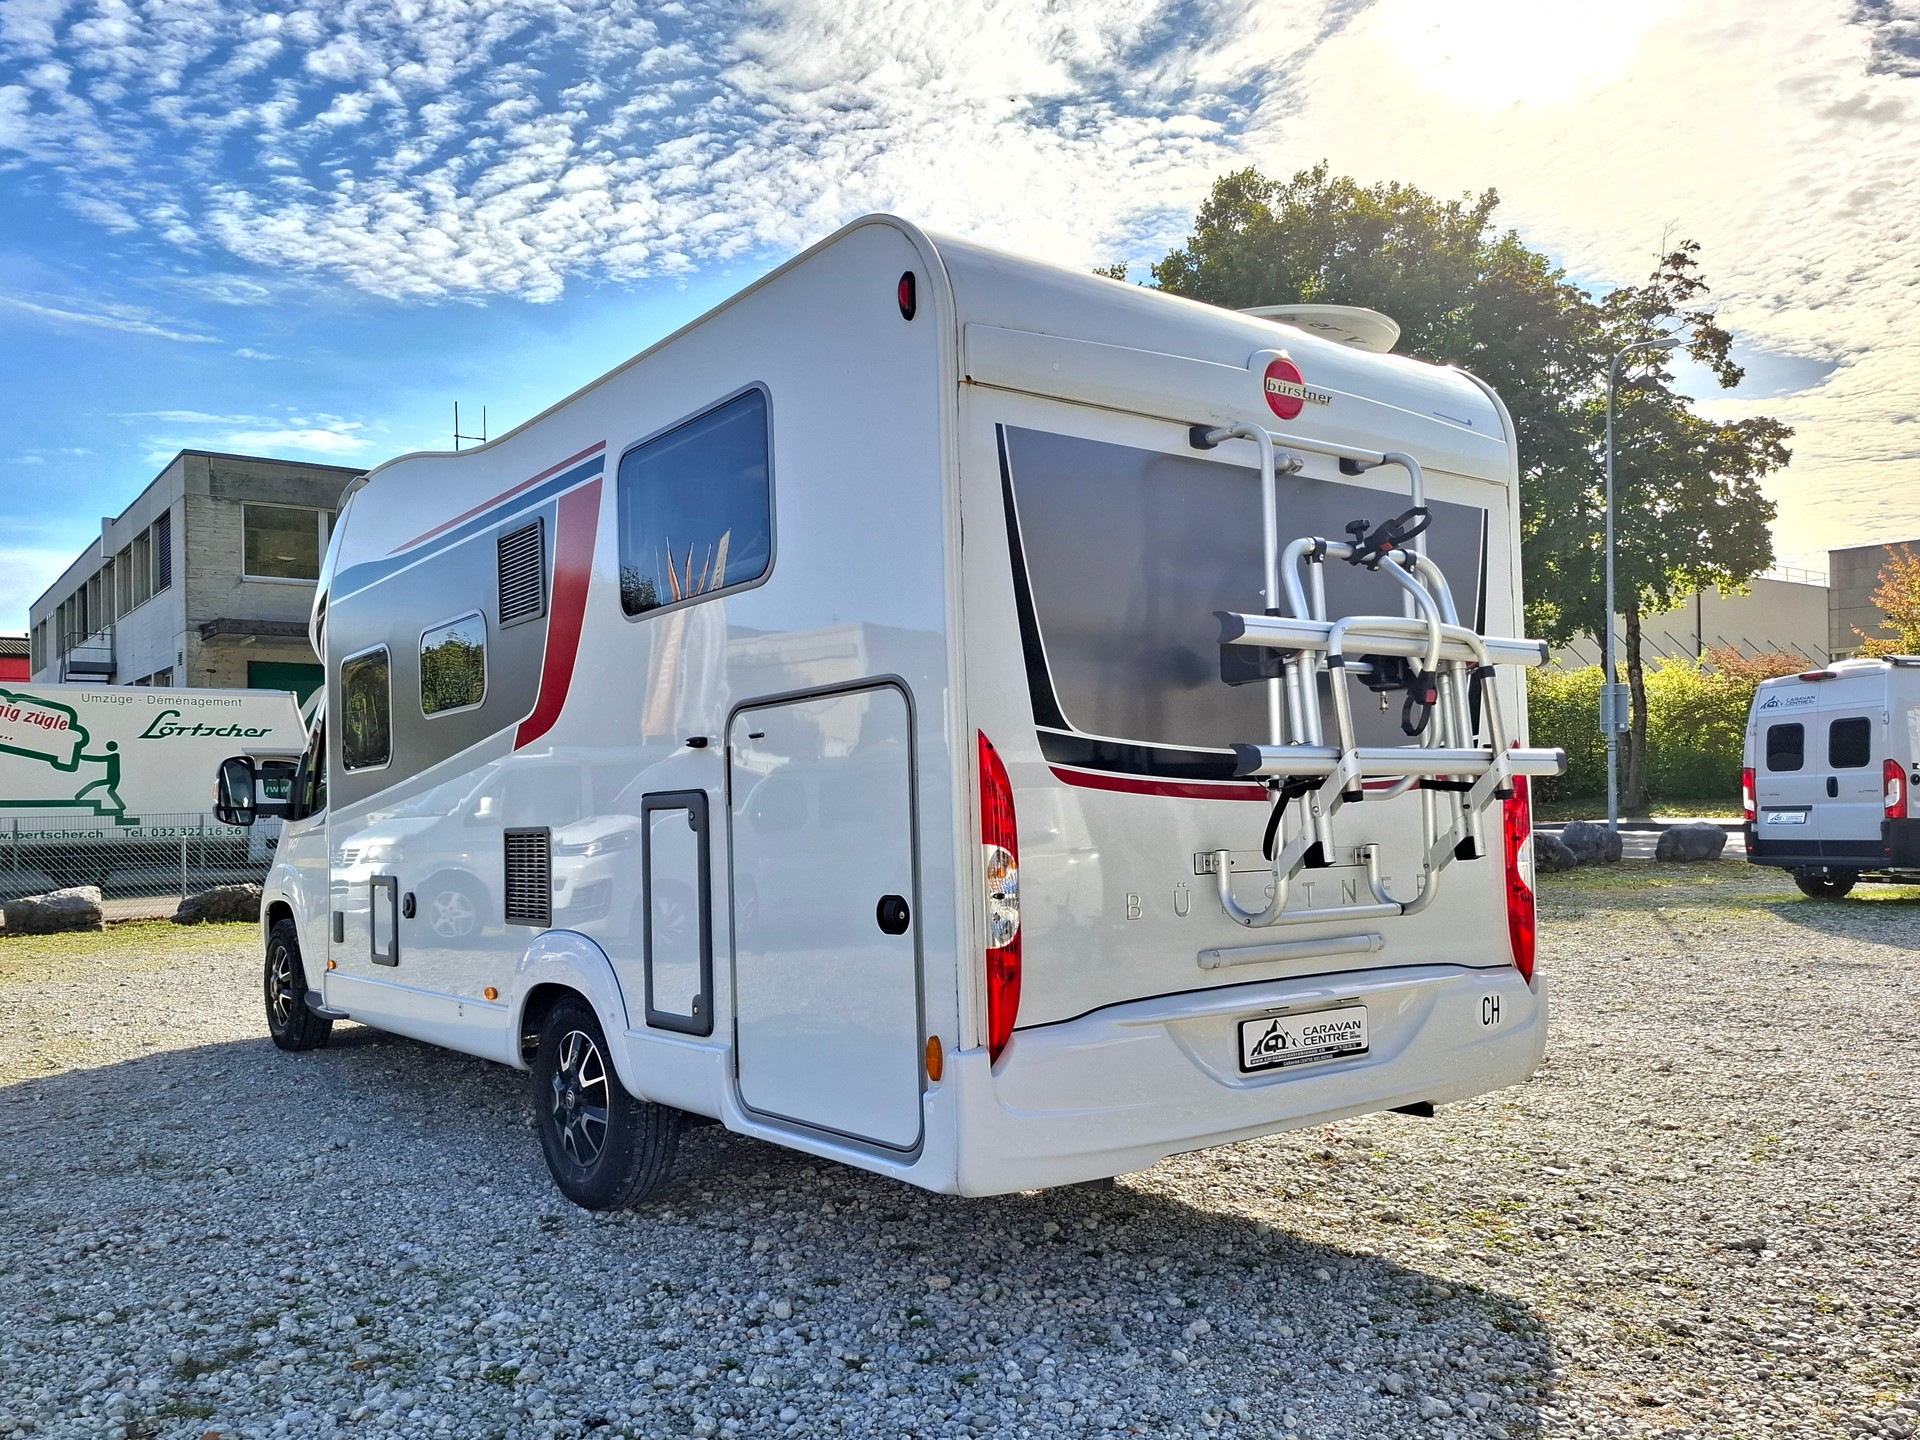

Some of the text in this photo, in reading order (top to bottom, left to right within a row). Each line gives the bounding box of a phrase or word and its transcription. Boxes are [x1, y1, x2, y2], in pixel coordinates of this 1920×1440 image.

[1267, 379, 1332, 404] bürstner
[81, 693, 133, 706] Umzüge
[147, 694, 242, 708] Déménagement
[23, 711, 68, 731] zügle
[137, 709, 274, 739] Lörtscher
[123, 828, 146, 838] Tel.
[151, 828, 175, 837] 032
[179, 827, 201, 837] 322
[208, 827, 222, 836] 16
[227, 827, 242, 836] 56
[1482, 995, 1499, 1026] CH
[1303, 1020, 1361, 1036] CARAVAN
[1304, 1031, 1348, 1046] CENTRE
